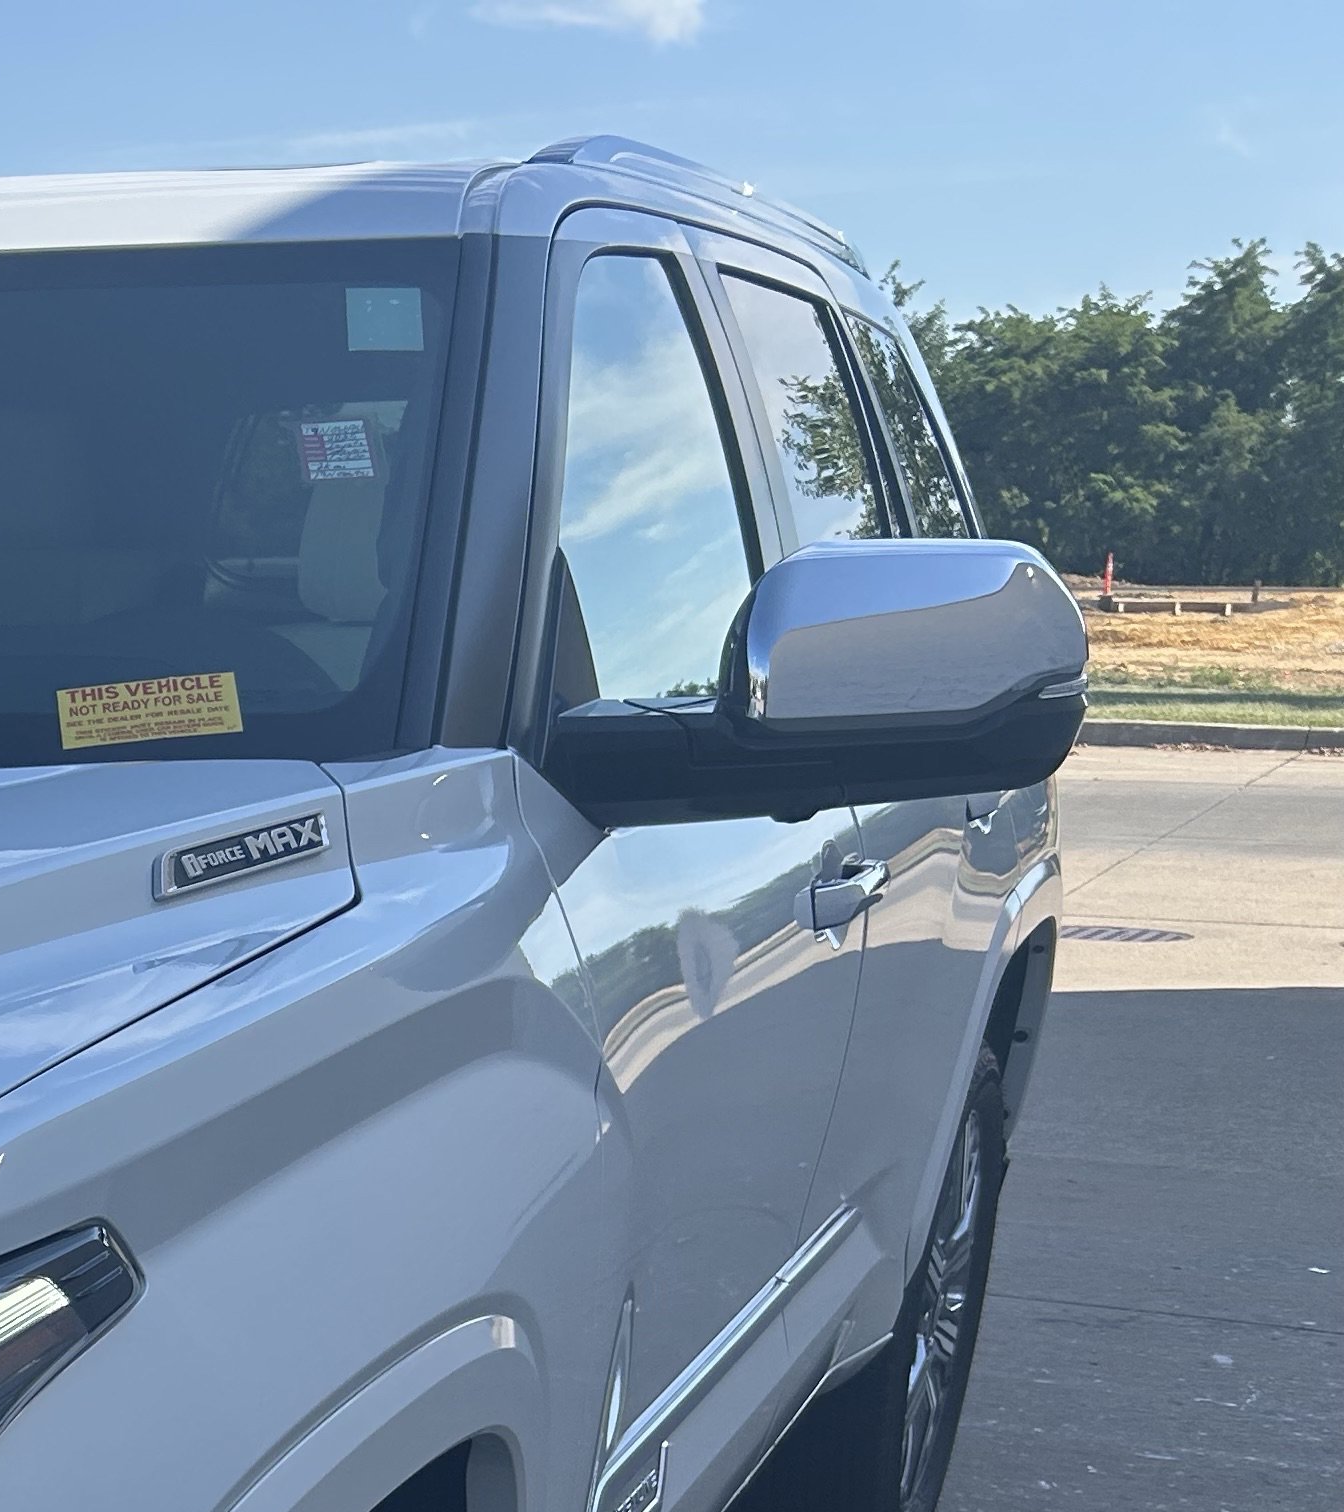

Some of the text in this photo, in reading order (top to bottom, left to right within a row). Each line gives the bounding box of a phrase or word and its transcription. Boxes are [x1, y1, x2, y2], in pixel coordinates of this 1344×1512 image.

[65, 675, 223, 703] THIS VEHICLE
[66, 719, 83, 728] SEE
[87, 717, 105, 726] THE
[107, 714, 142, 723] DEALER
[167, 708, 203, 717] RESALE
[207, 705, 230, 713] DATE
[68, 691, 223, 718] NOT READY FOR SALE
[244, 818, 321, 860] MAX
